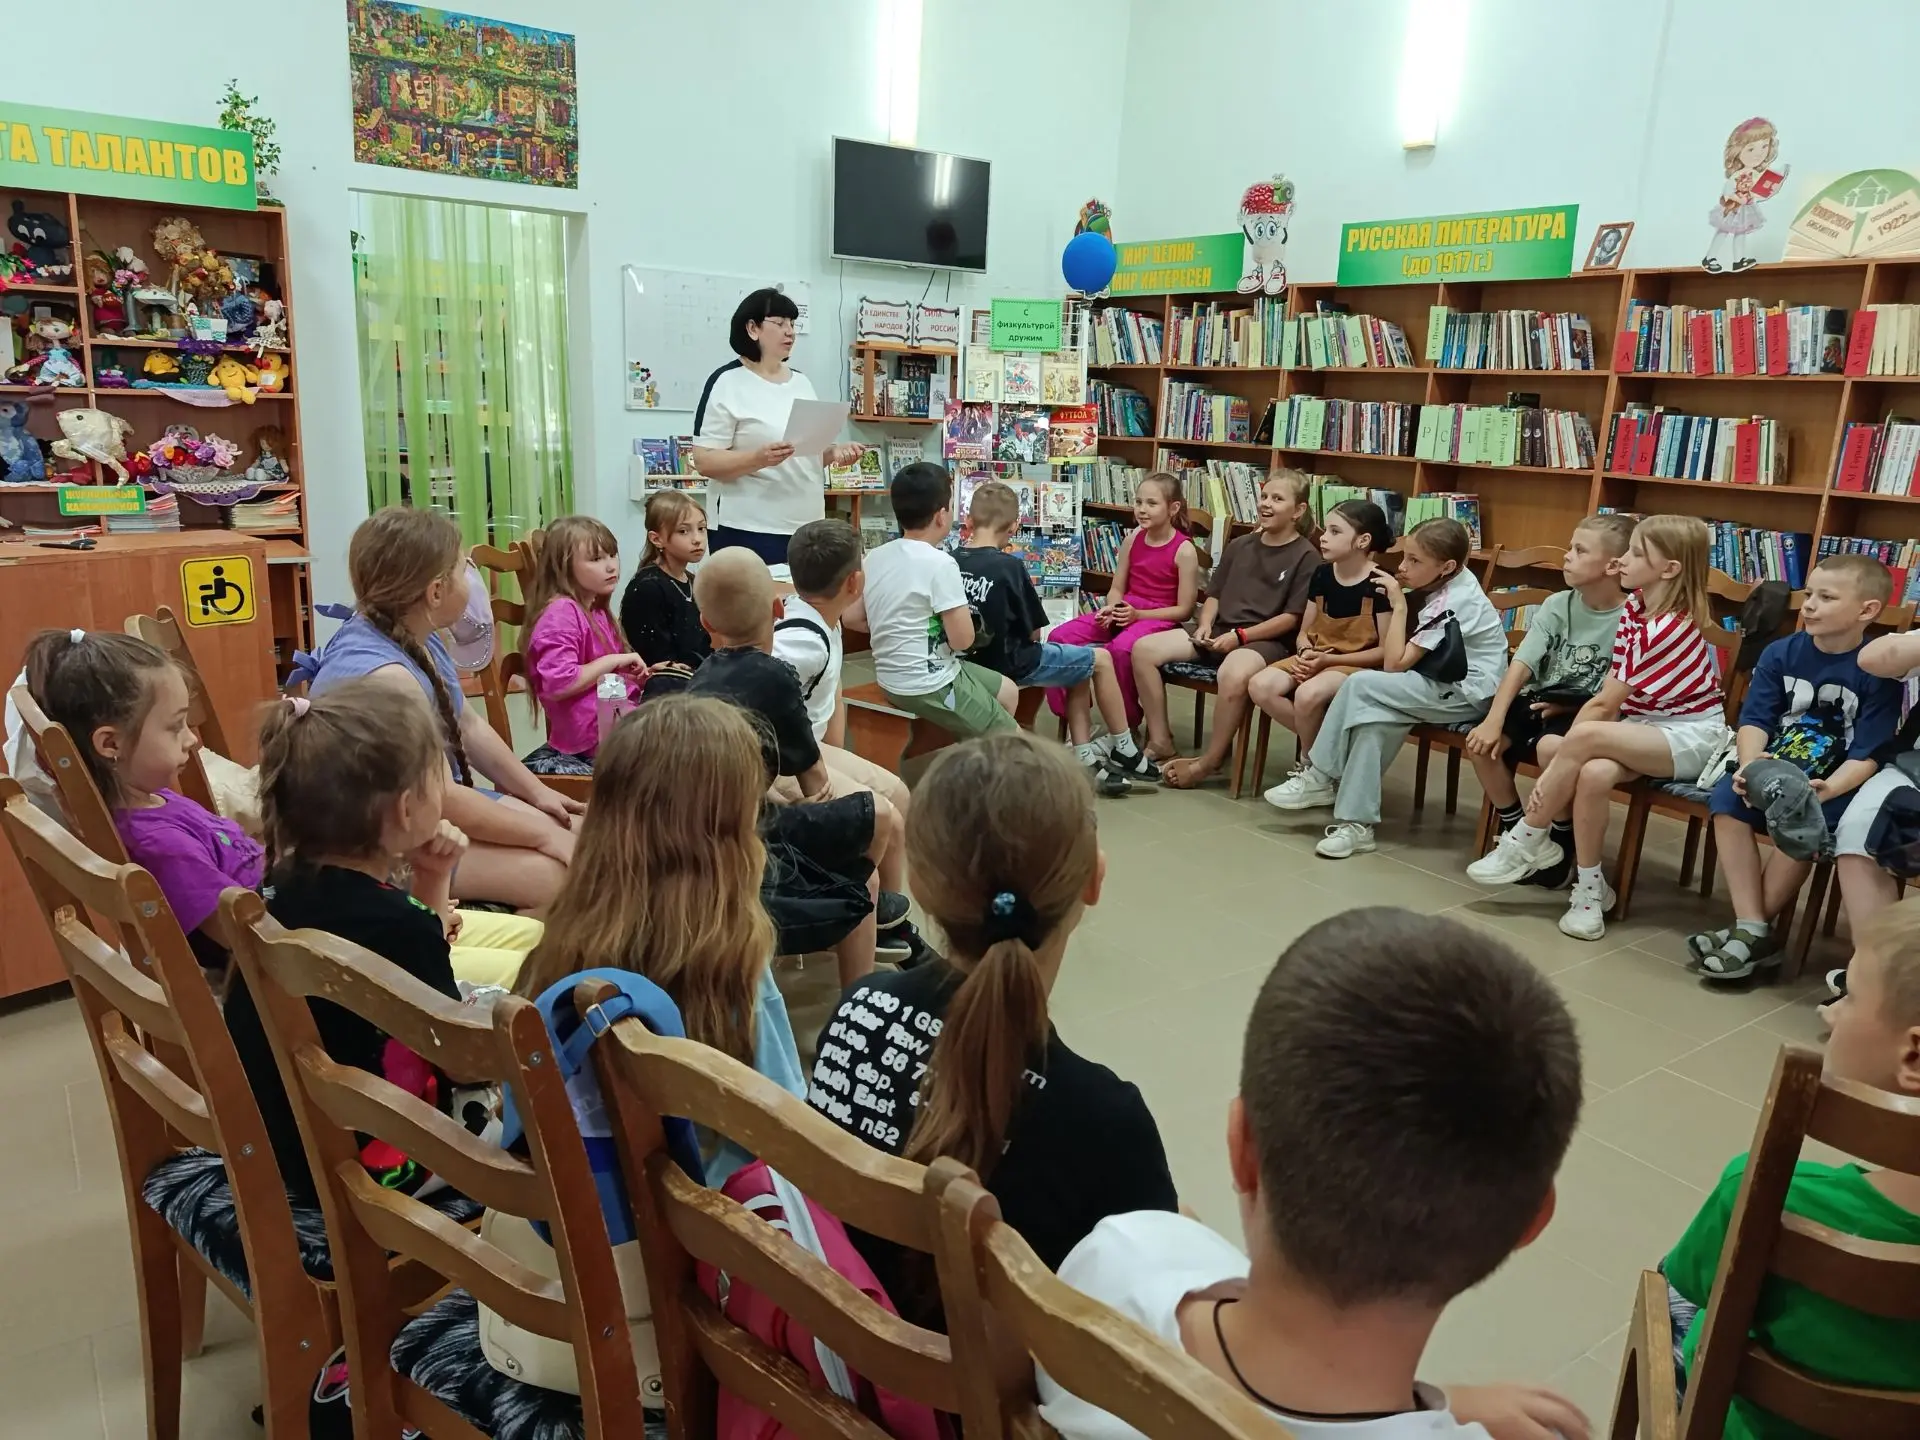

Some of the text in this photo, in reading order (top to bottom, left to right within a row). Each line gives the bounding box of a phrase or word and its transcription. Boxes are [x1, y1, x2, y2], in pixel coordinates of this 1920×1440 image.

[41, 126, 249, 186] ТАЛАНТОВ
[1878, 213, 1908, 236] 1922
[1347, 212, 1566, 252] РУССКАЯ ЛИТЕРАТУРА
[1123, 246, 1149, 266] МИР
[1152, 242, 1195, 264] ВЕЛИК
[1402, 254, 1431, 277] (до
[1435, 251, 1471, 275] 1917
[1111, 267, 1212, 291] МИР ИНТЕРЕСЕН
[869, 310, 899, 318] ЕДИНСТВЕ
[924, 309, 943, 318] СИЛА
[874, 323, 903, 331] НАРОДОВ
[930, 324, 957, 332] РОССИИ
[997, 320, 1055, 331] физкультурой
[1008, 334, 1043, 342] дружим
[1352, 337, 1361, 348] В
[1060, 411, 1087, 420] ФУТБОЛ
[1422, 426, 1431, 438] Р
[1440, 431, 1448, 442] С
[1465, 432, 1475, 443] Т
[855, 1062, 895, 1094] dep.
[853, 1083, 896, 1117] East
[860, 1117, 900, 1147] n52
